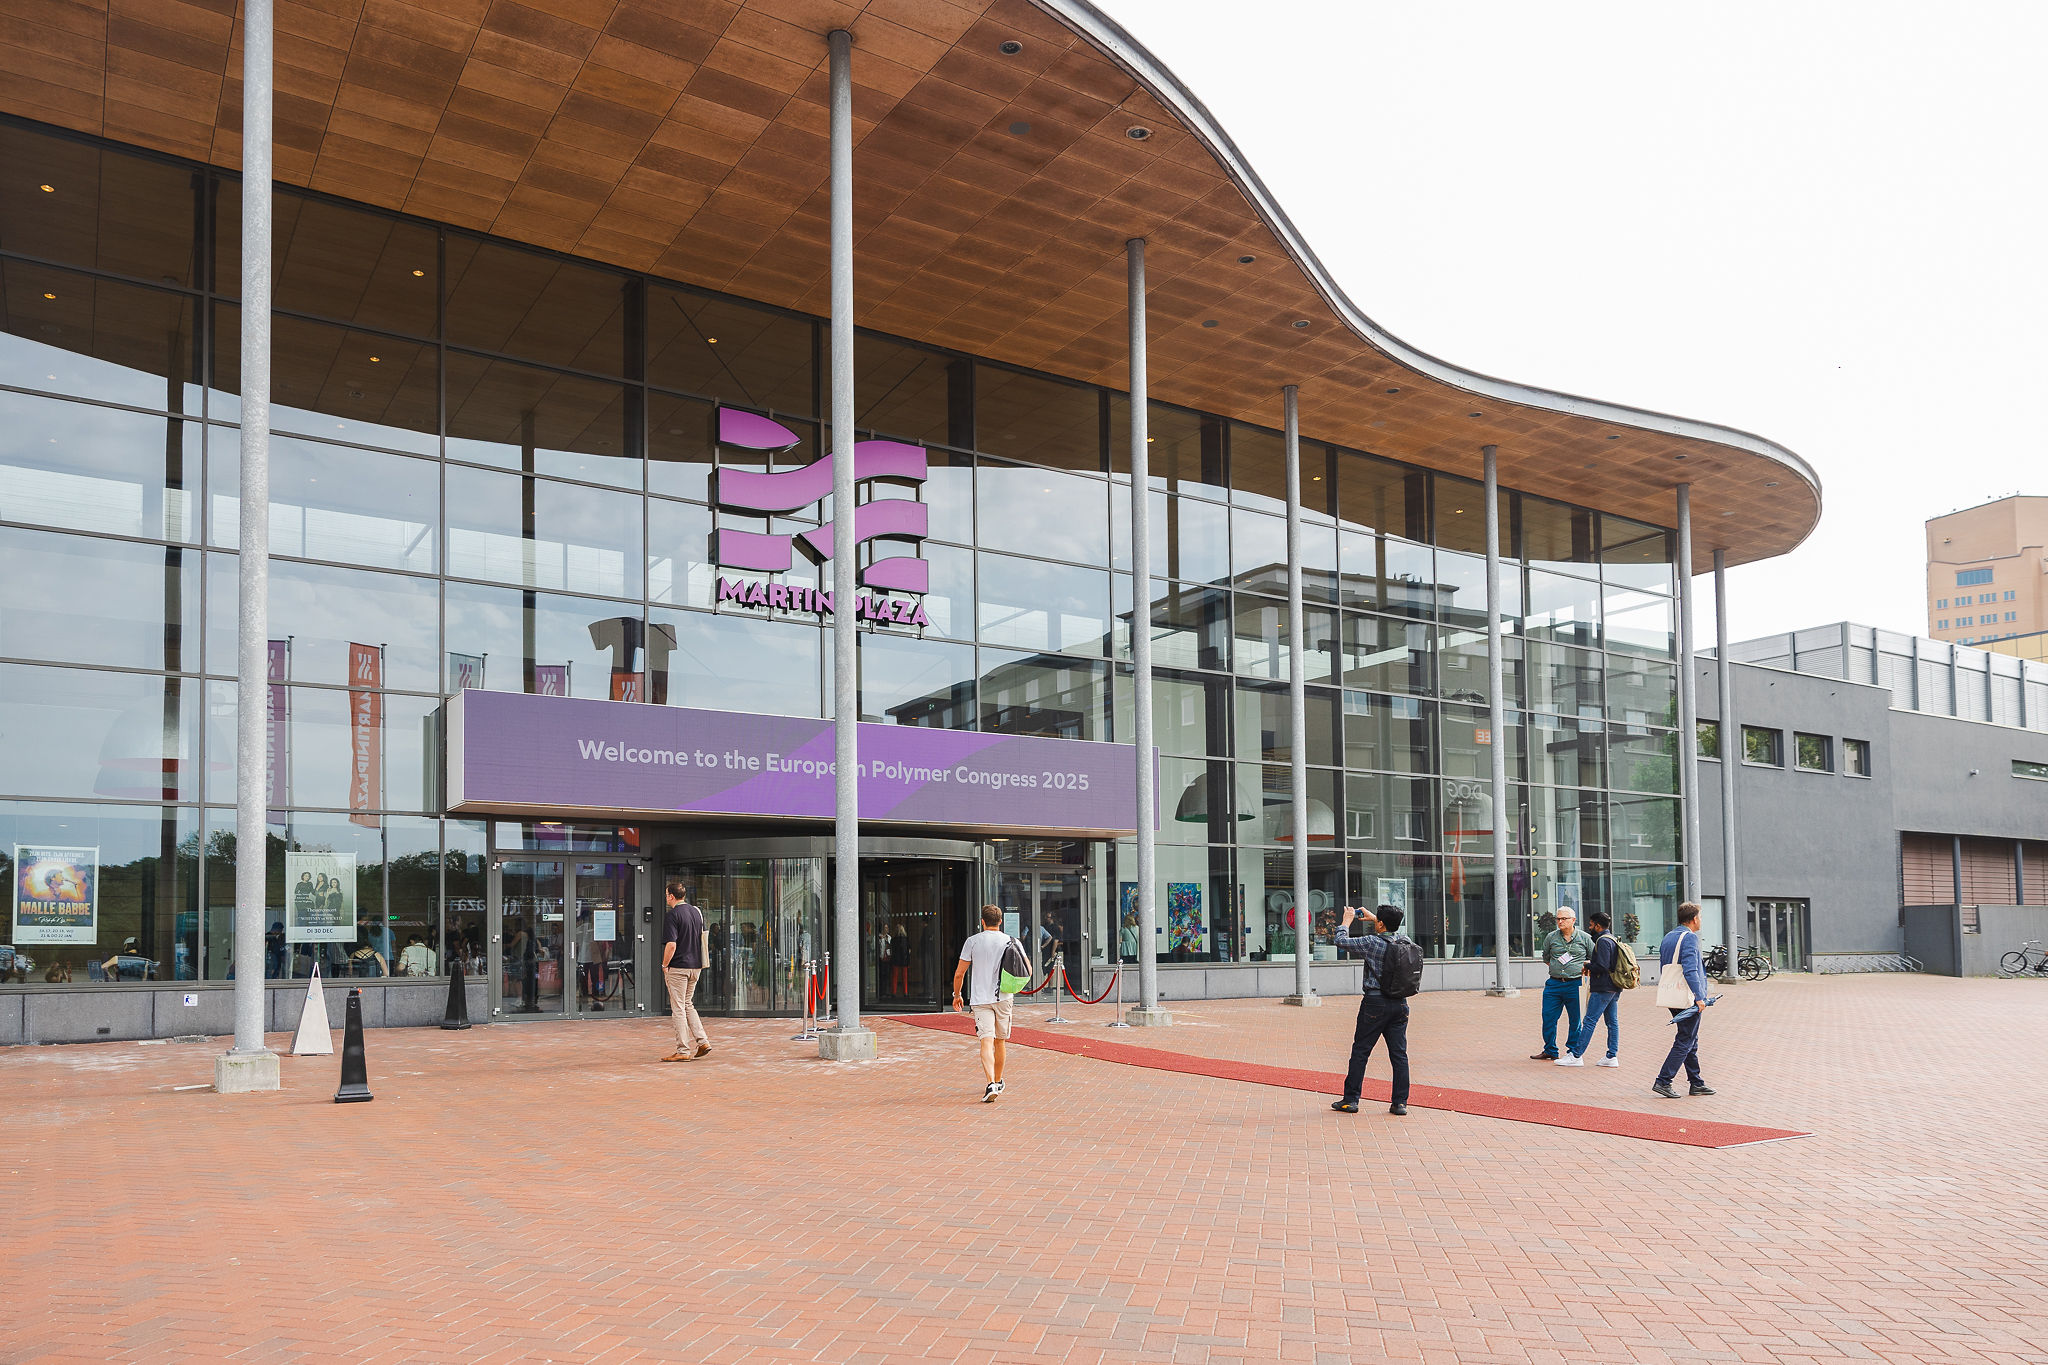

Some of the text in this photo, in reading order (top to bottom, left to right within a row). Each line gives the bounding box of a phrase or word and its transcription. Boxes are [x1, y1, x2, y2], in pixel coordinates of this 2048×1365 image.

[577, 739, 1089, 790] Welcome to the Europen Polymer Congress 2025
[20, 901, 91, 915] MALLE BABBE
